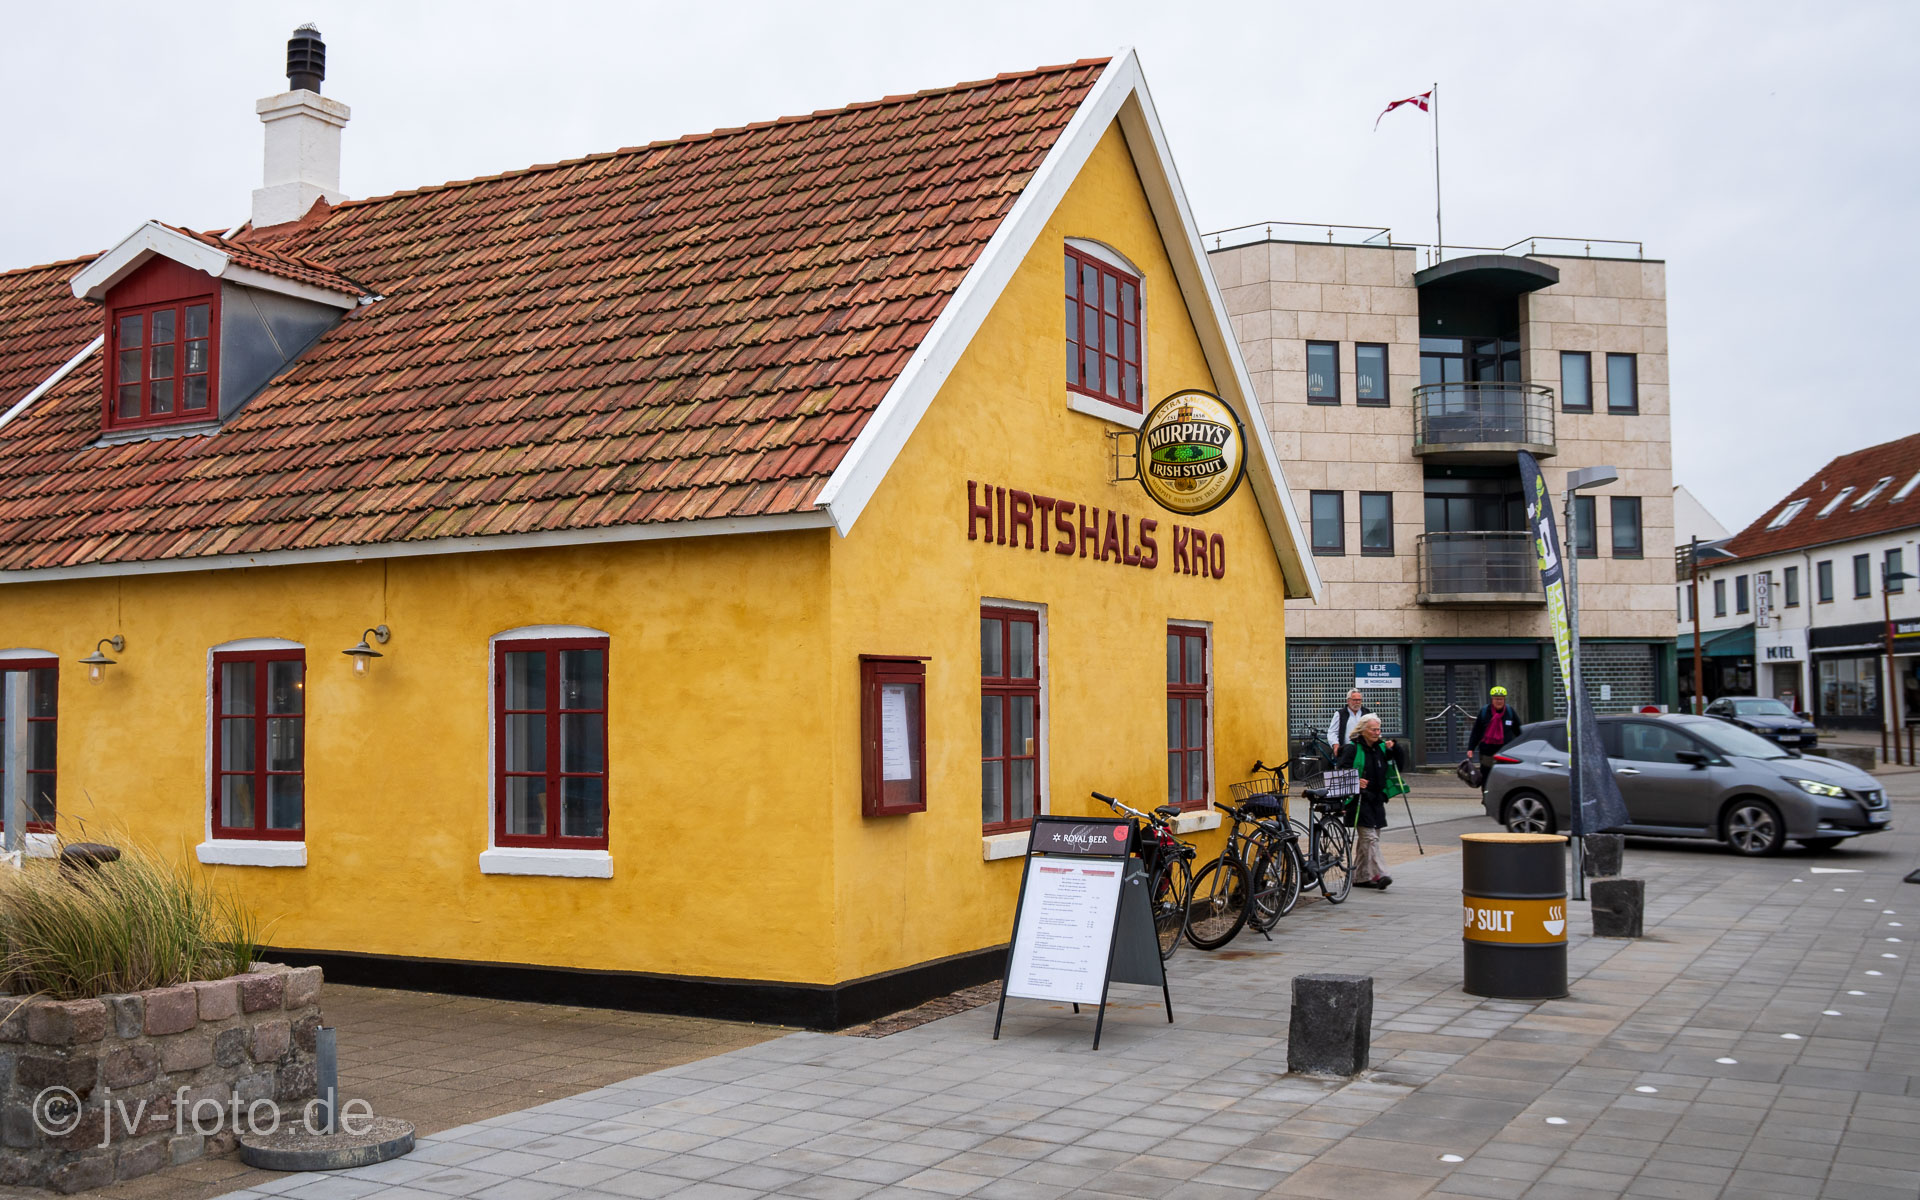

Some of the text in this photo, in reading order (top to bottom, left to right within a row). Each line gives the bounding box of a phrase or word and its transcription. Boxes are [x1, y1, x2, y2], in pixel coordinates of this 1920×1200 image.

[1157, 396, 1221, 419] EXTRA SMOOTH
[1150, 423, 1226, 449] MURPHY'S
[1153, 459, 1221, 477] IRISH STOUT
[1152, 475, 1226, 504] MURPHY BREWERY IRELAND
[967, 479, 1225, 580] HIRTSHALS KRO
[1757, 575, 1768, 626] HOTEL
[1766, 646, 1795, 660] HOTEL
[1063, 834, 1108, 844] ROYAL BEER
[1477, 908, 1514, 932] SULT
